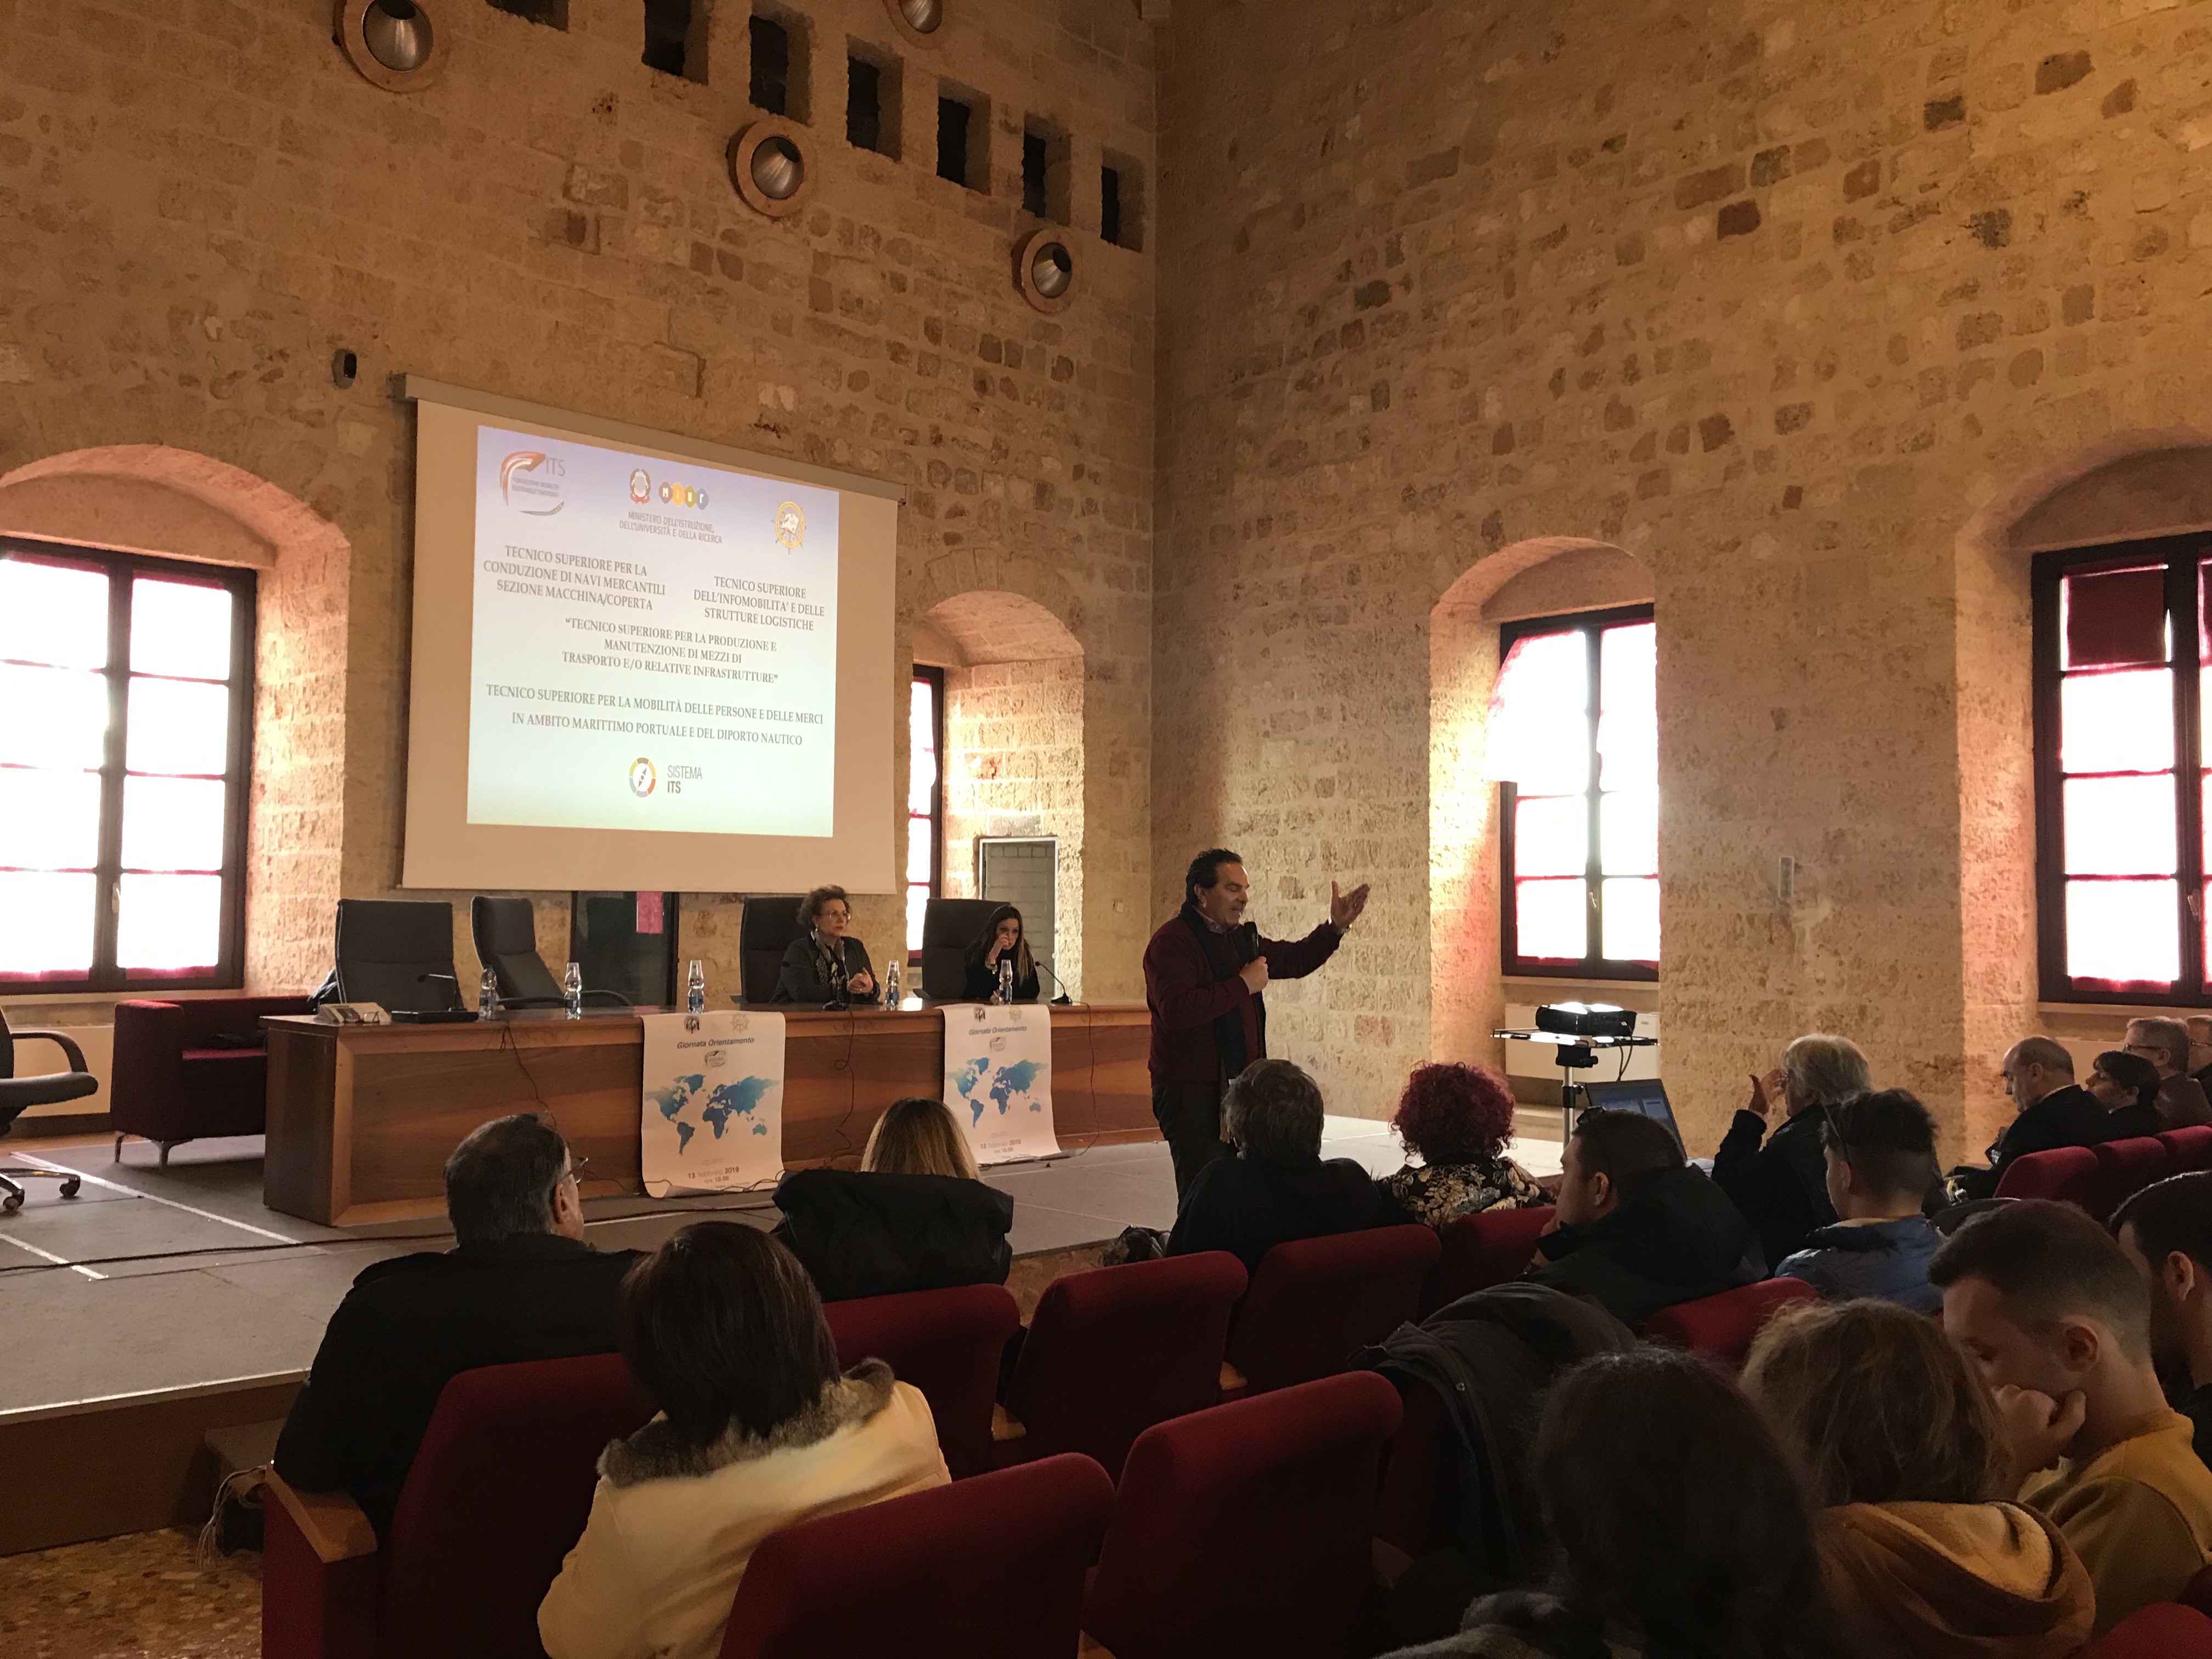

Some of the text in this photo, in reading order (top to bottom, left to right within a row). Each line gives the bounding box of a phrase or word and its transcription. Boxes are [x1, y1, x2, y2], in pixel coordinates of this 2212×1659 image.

[546, 456, 566, 476] ITS
[619, 520, 723, 544] DELL'UNIVERSITÀ E DELLA RICERCA
[628, 511, 715, 534] MINISTERO DELL'ISTRUZIONE,
[505, 545, 647, 577] TECNICO SUPERIORE PER LA
[483, 560, 665, 596] CONDUZIONE DI NAVI MERCANTILI
[714, 575, 806, 599] TECNICO SUPERIORE
[497, 579, 653, 611] SEZIONE MACCHINA/COPERTA
[704, 607, 814, 631] STRUTTURE LOGISTICHE
[791, 602, 796, 613] E
[798, 603, 825, 617] DELLE
[618, 624, 672, 640] SUPERIORE
[675, 630, 693, 642] PER
[695, 633, 706, 644] LA
[708, 634, 769, 651] PRODUZIONE
[771, 642, 777, 652] E
[562, 651, 621, 668] TRASPORTO
[623, 658, 642, 670] E/O
[645, 660, 691, 675] RELATIVE
[604, 639, 742, 663] MANUTENZIONE DI MEZZI DI
[486, 684, 823, 725] TECNICO SUPERIORE PER LA MOBILITÀ DELLE PERSONE E DELLE MERCI
[512, 712, 803, 746] IN AMBITO MARITTIMO PORTUALE E DEL DIPORTO NAUTICO
[667, 765, 703, 780] SISTEMA
[667, 781, 681, 794] ITS
[677, 1037, 754, 1049] Giornata Orientamento
[725, 1166, 740, 1174] 2019
